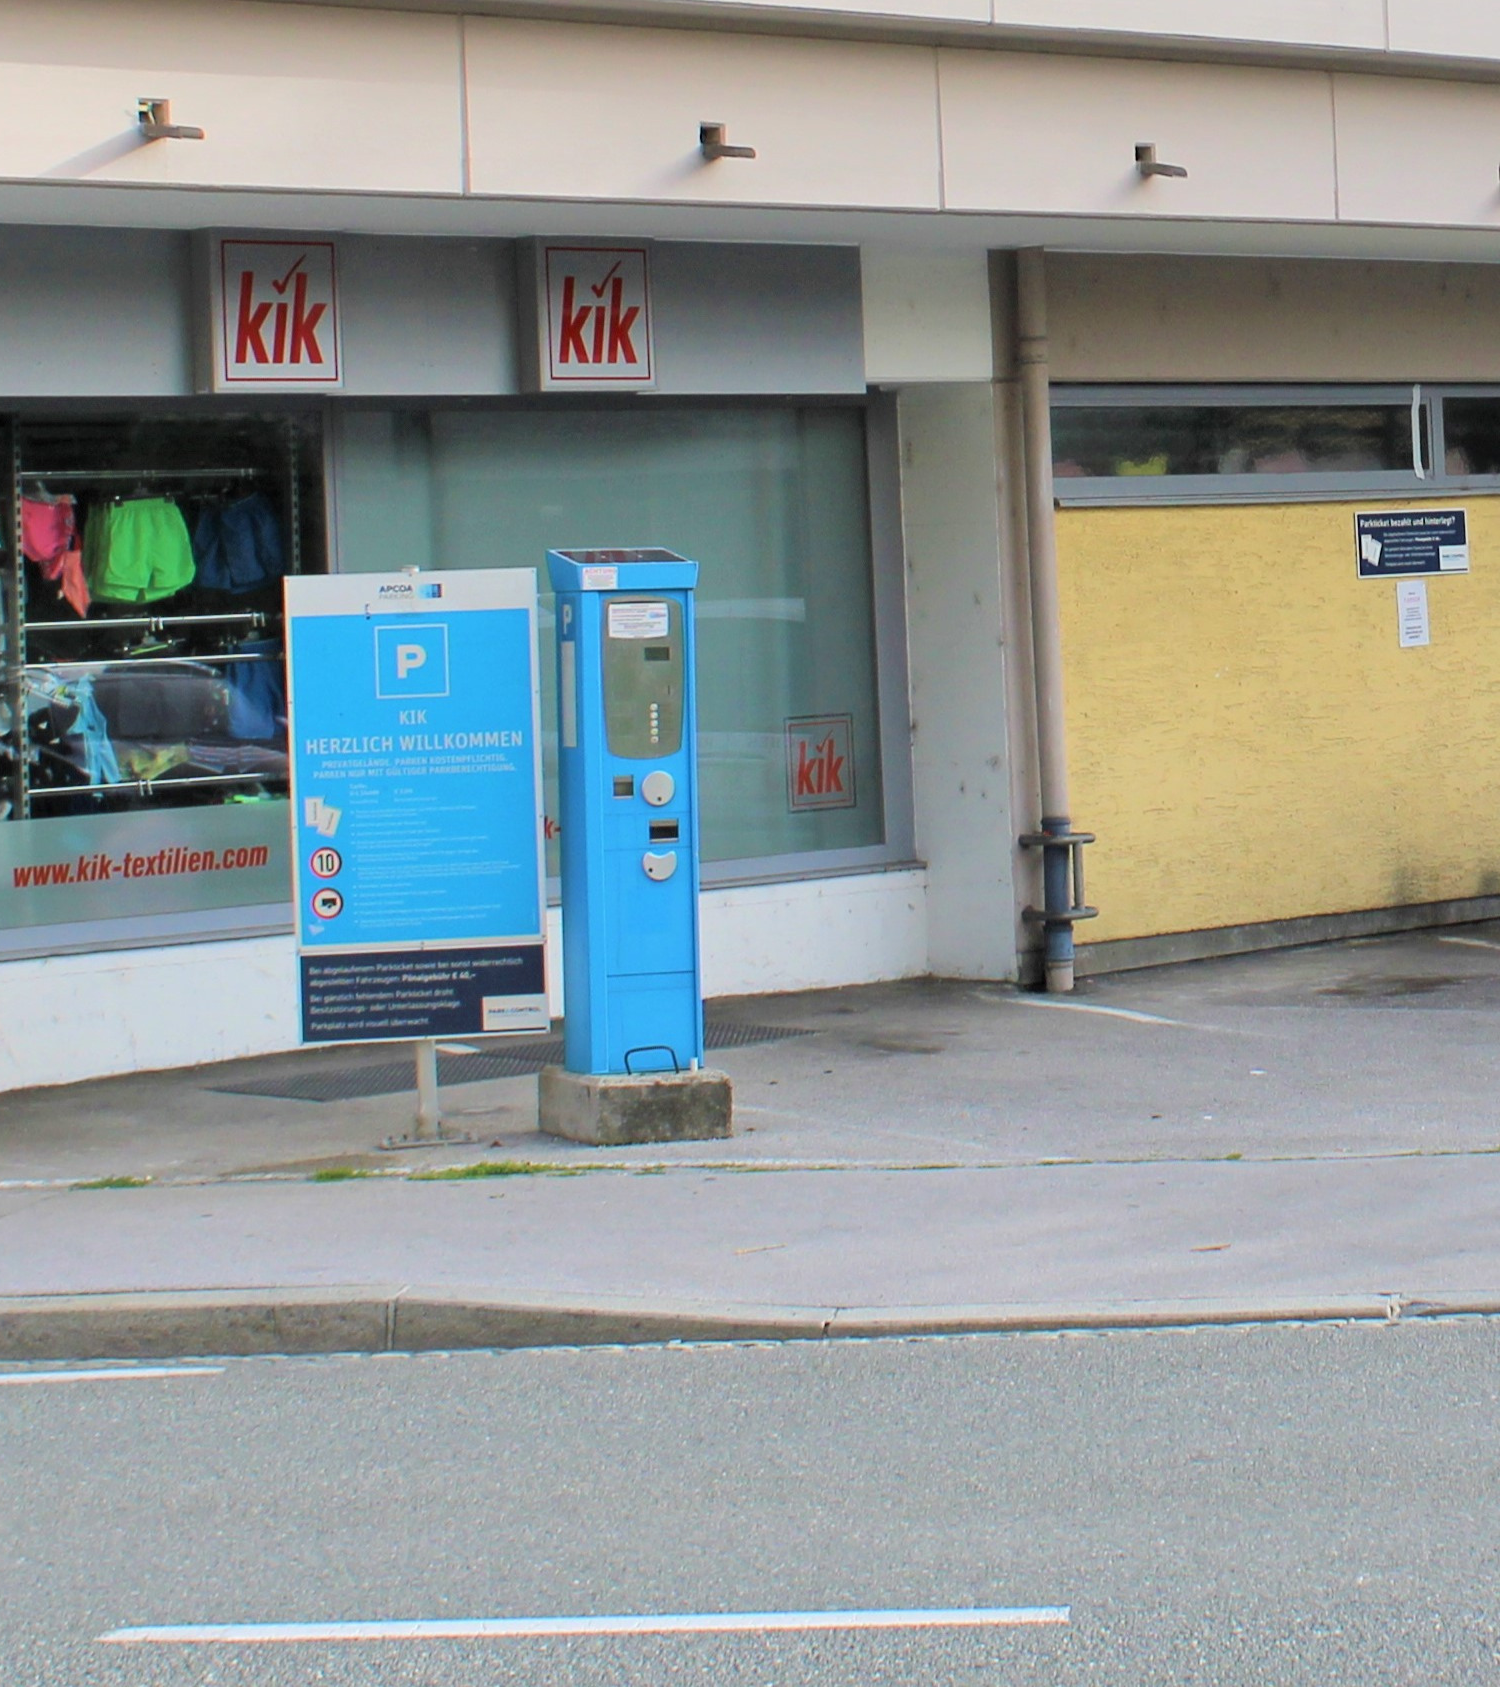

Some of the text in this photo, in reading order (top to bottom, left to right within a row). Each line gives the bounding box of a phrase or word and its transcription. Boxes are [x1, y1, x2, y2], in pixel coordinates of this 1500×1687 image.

[235, 254, 327, 364] kik
[558, 260, 640, 364] kik
[1390, 518, 1412, 527] bezahlt
[1412, 517, 1424, 526] und
[379, 584, 413, 593] APCOA
[396, 644, 427, 679] P
[399, 710, 428, 725] KIK
[305, 731, 524, 755] HERZLICH WILLKOMMEN
[367, 767, 383, 777] MIT
[796, 730, 845, 797] kik
[13, 845, 269, 889] www.kik-textilien.com
[316, 853, 335, 873] 10
